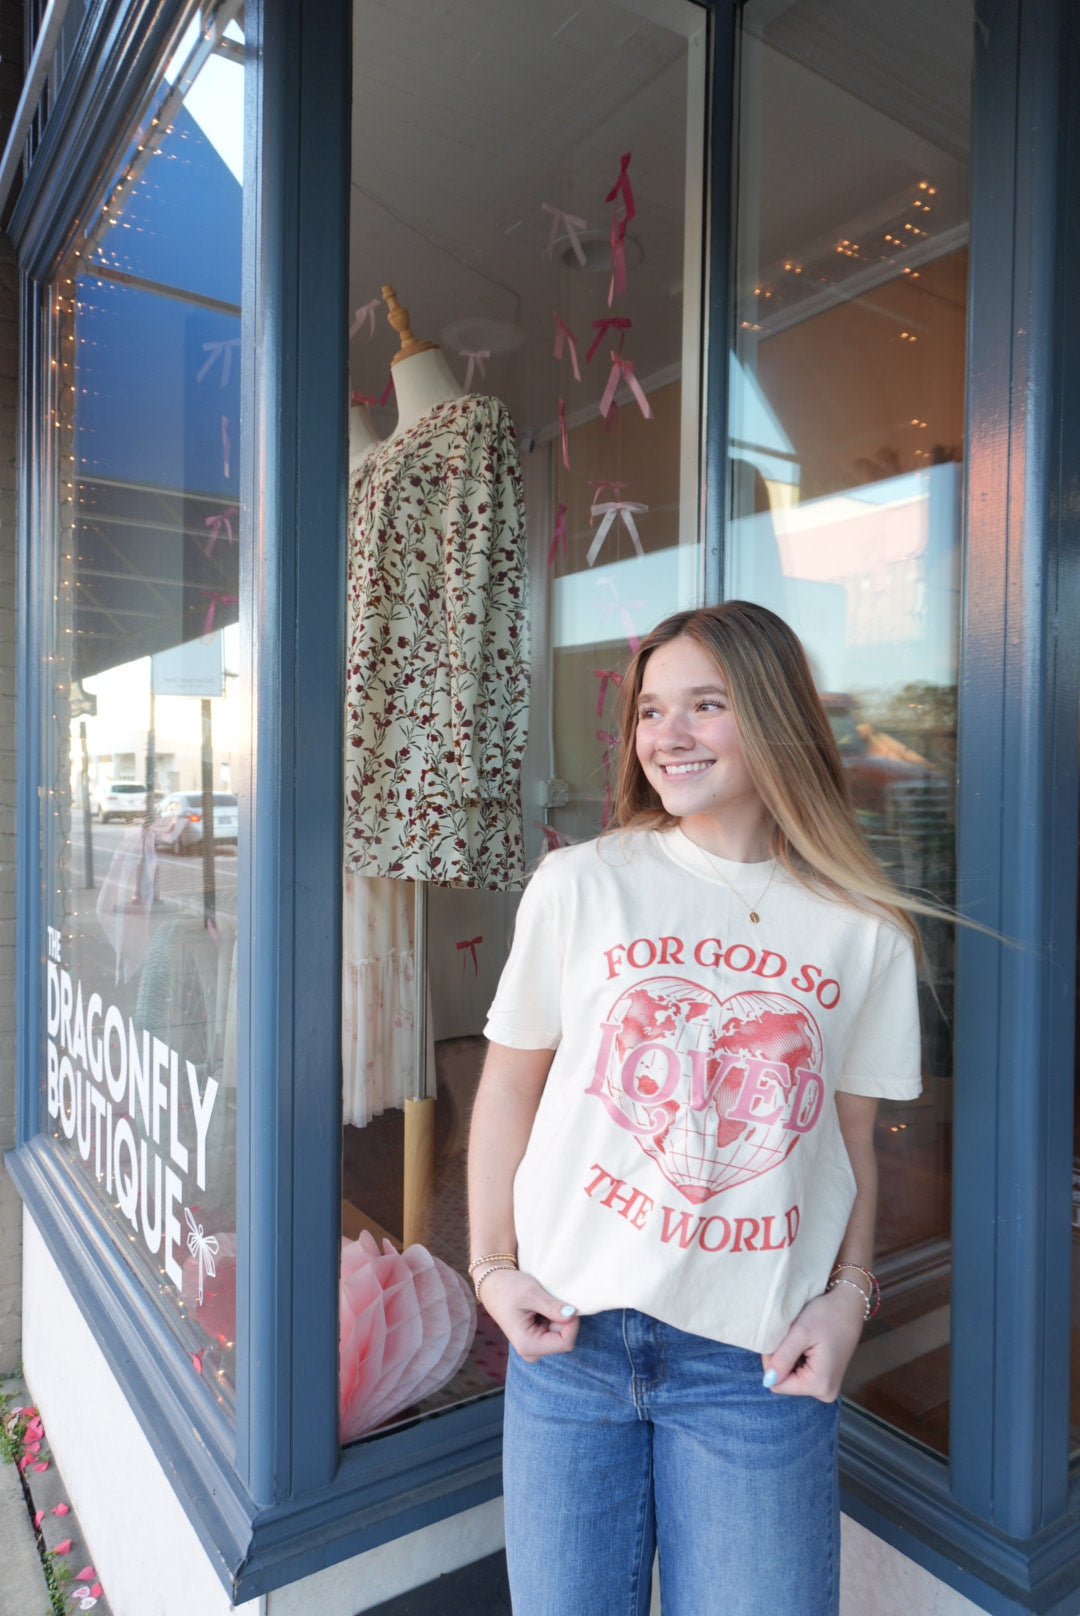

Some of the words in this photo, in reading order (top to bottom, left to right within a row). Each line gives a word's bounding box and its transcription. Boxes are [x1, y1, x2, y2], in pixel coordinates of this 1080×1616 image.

[47, 926, 61, 962] THE
[603, 936, 685, 980] FOR
[693, 938, 787, 979] GOD
[791, 964, 841, 1010] SO
[47, 960, 218, 1191] DRAGONFLY
[584, 1022, 825, 1136] LOVED
[47, 1038, 183, 1292] BOUTIQUE
[583, 1163, 655, 1232] THE
[660, 1204, 800, 1254] WORLD
